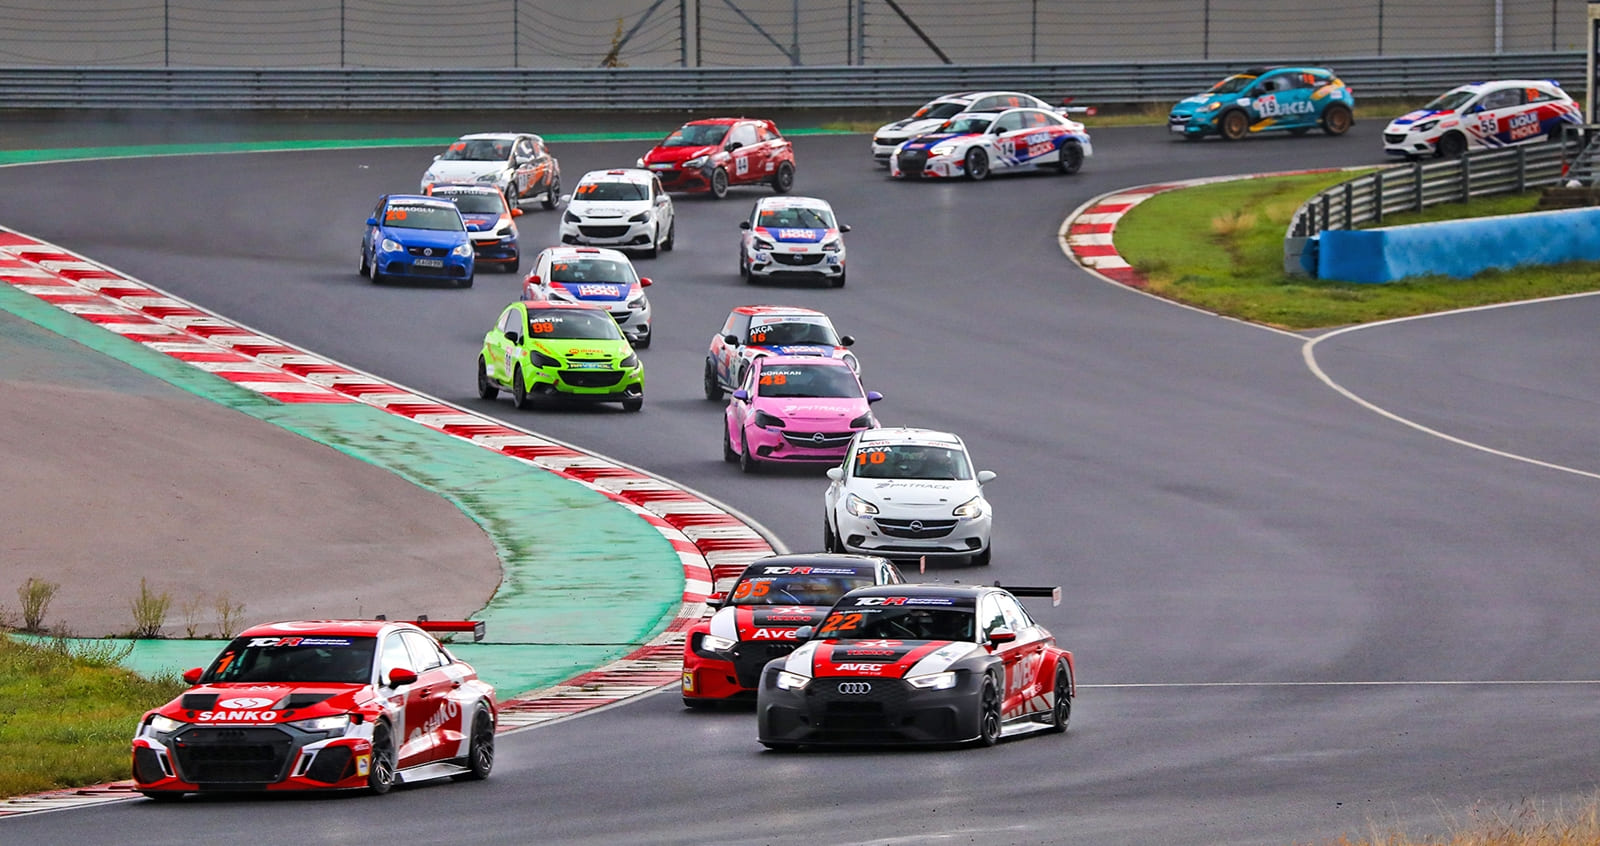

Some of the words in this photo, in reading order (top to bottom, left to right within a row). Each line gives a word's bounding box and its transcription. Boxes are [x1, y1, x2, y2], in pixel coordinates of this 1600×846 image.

[1481, 119, 1496, 133] 55
[1002, 142, 1014, 155] 14
[386, 210, 407, 221] 20
[532, 322, 554, 333] 99
[759, 375, 787, 386] 48
[858, 446, 892, 454] KAYA
[856, 451, 886, 465] 10
[763, 566, 812, 575] TCR
[735, 581, 771, 599] 95
[855, 597, 908, 606] TCR
[820, 614, 863, 633] 22
[752, 628, 799, 639] Ave
[247, 637, 303, 648] TCR
[216, 654, 235, 674] 1
[835, 663, 884, 671] AVEC
[198, 711, 277, 721] SANKO
